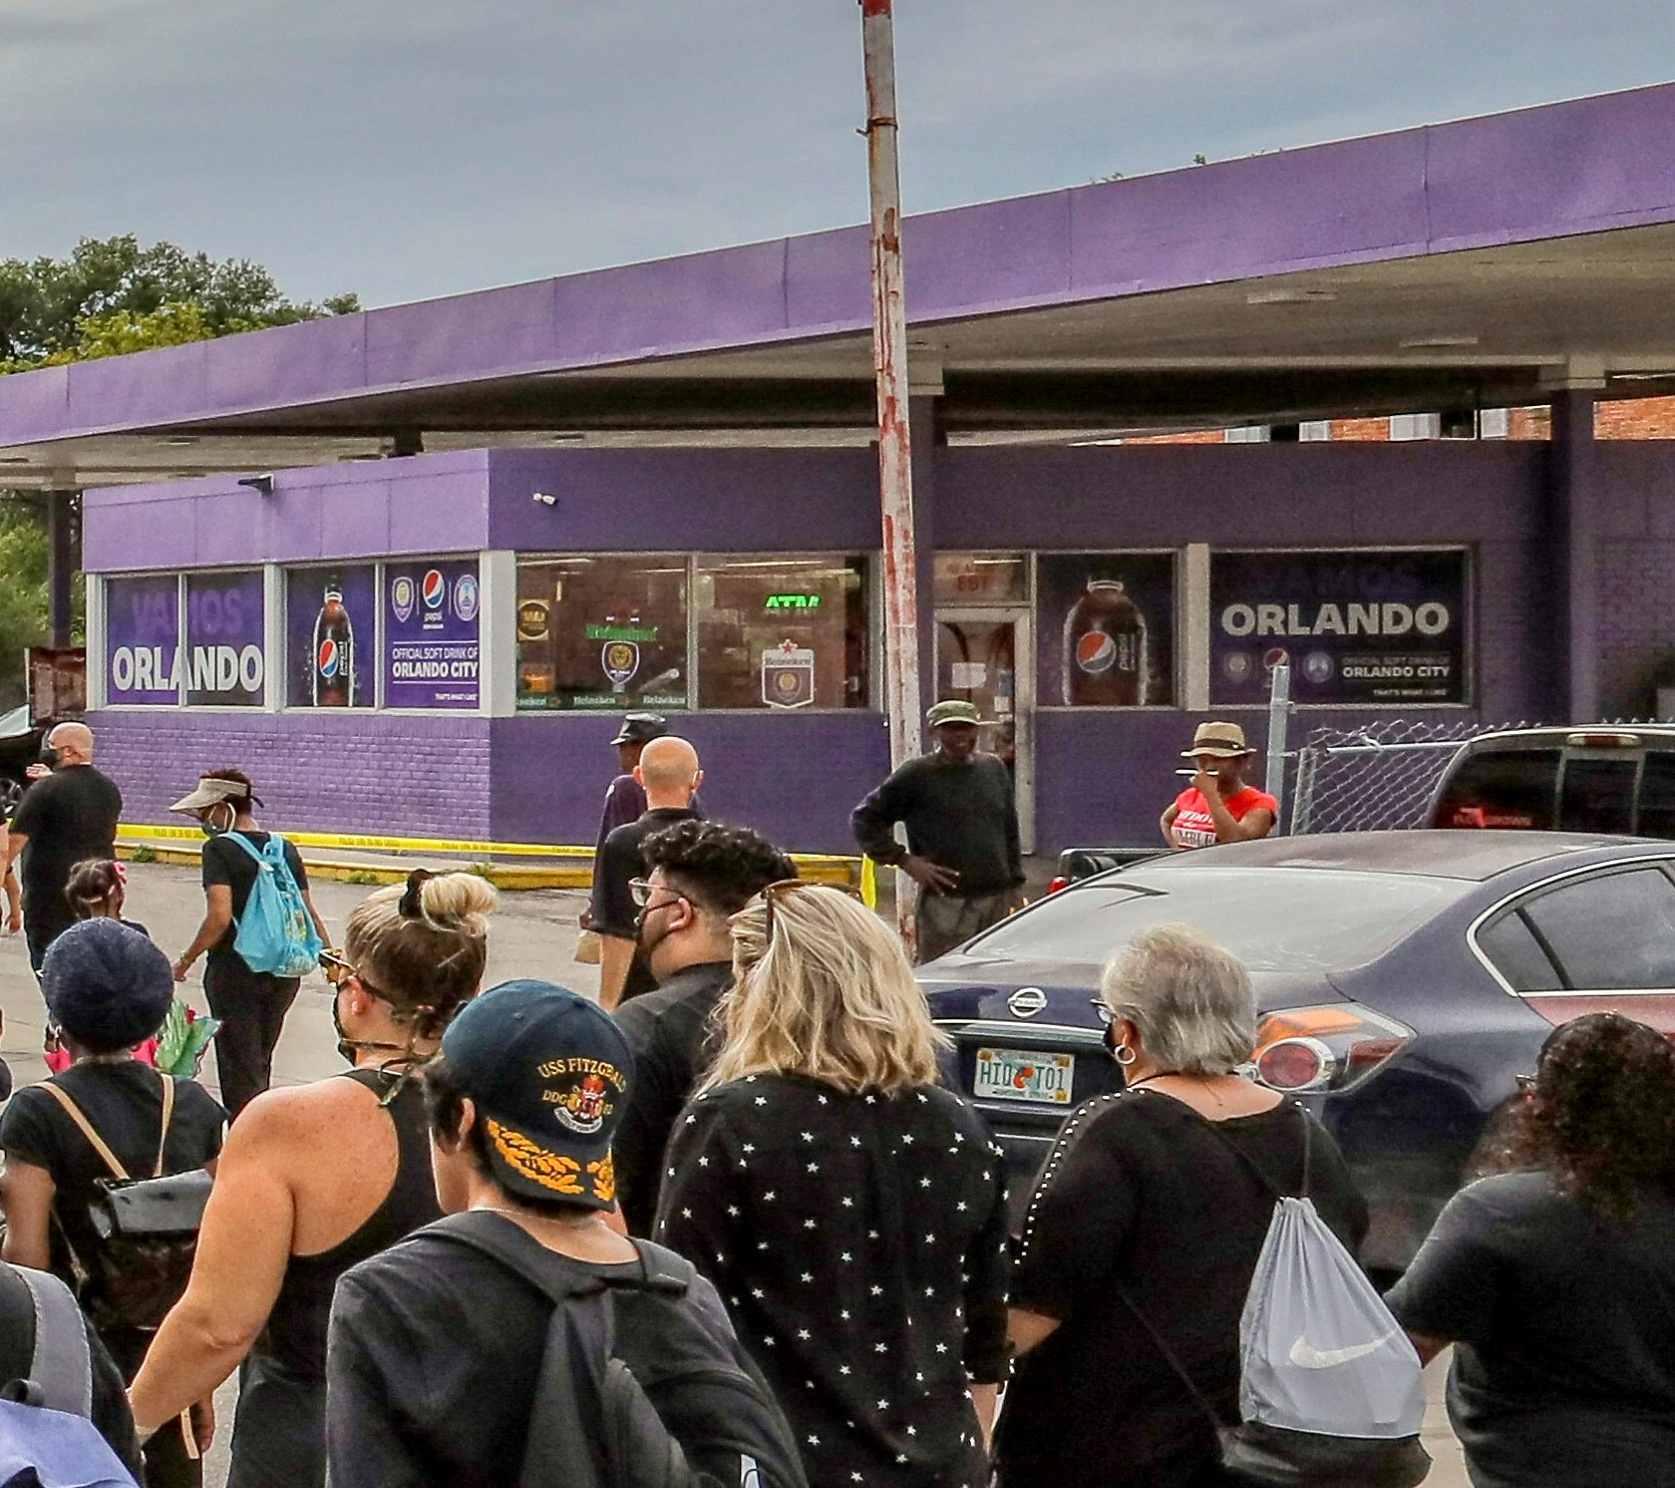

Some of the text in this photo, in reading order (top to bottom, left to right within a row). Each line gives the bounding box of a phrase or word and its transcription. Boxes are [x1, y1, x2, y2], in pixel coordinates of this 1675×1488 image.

[765, 595, 820, 608] ATM
[1221, 602, 1450, 636] ORLANDO
[392, 647, 478, 660] OFFICIAL SOFT DRINK OF
[112, 644, 265, 693] ORLANDO
[392, 661, 478, 678] ORLANDO CITY
[1342, 666, 1450, 678] ORLANDO CITY
[537, 1059, 566, 1078] USS
[542, 1089, 568, 1105] DDG
